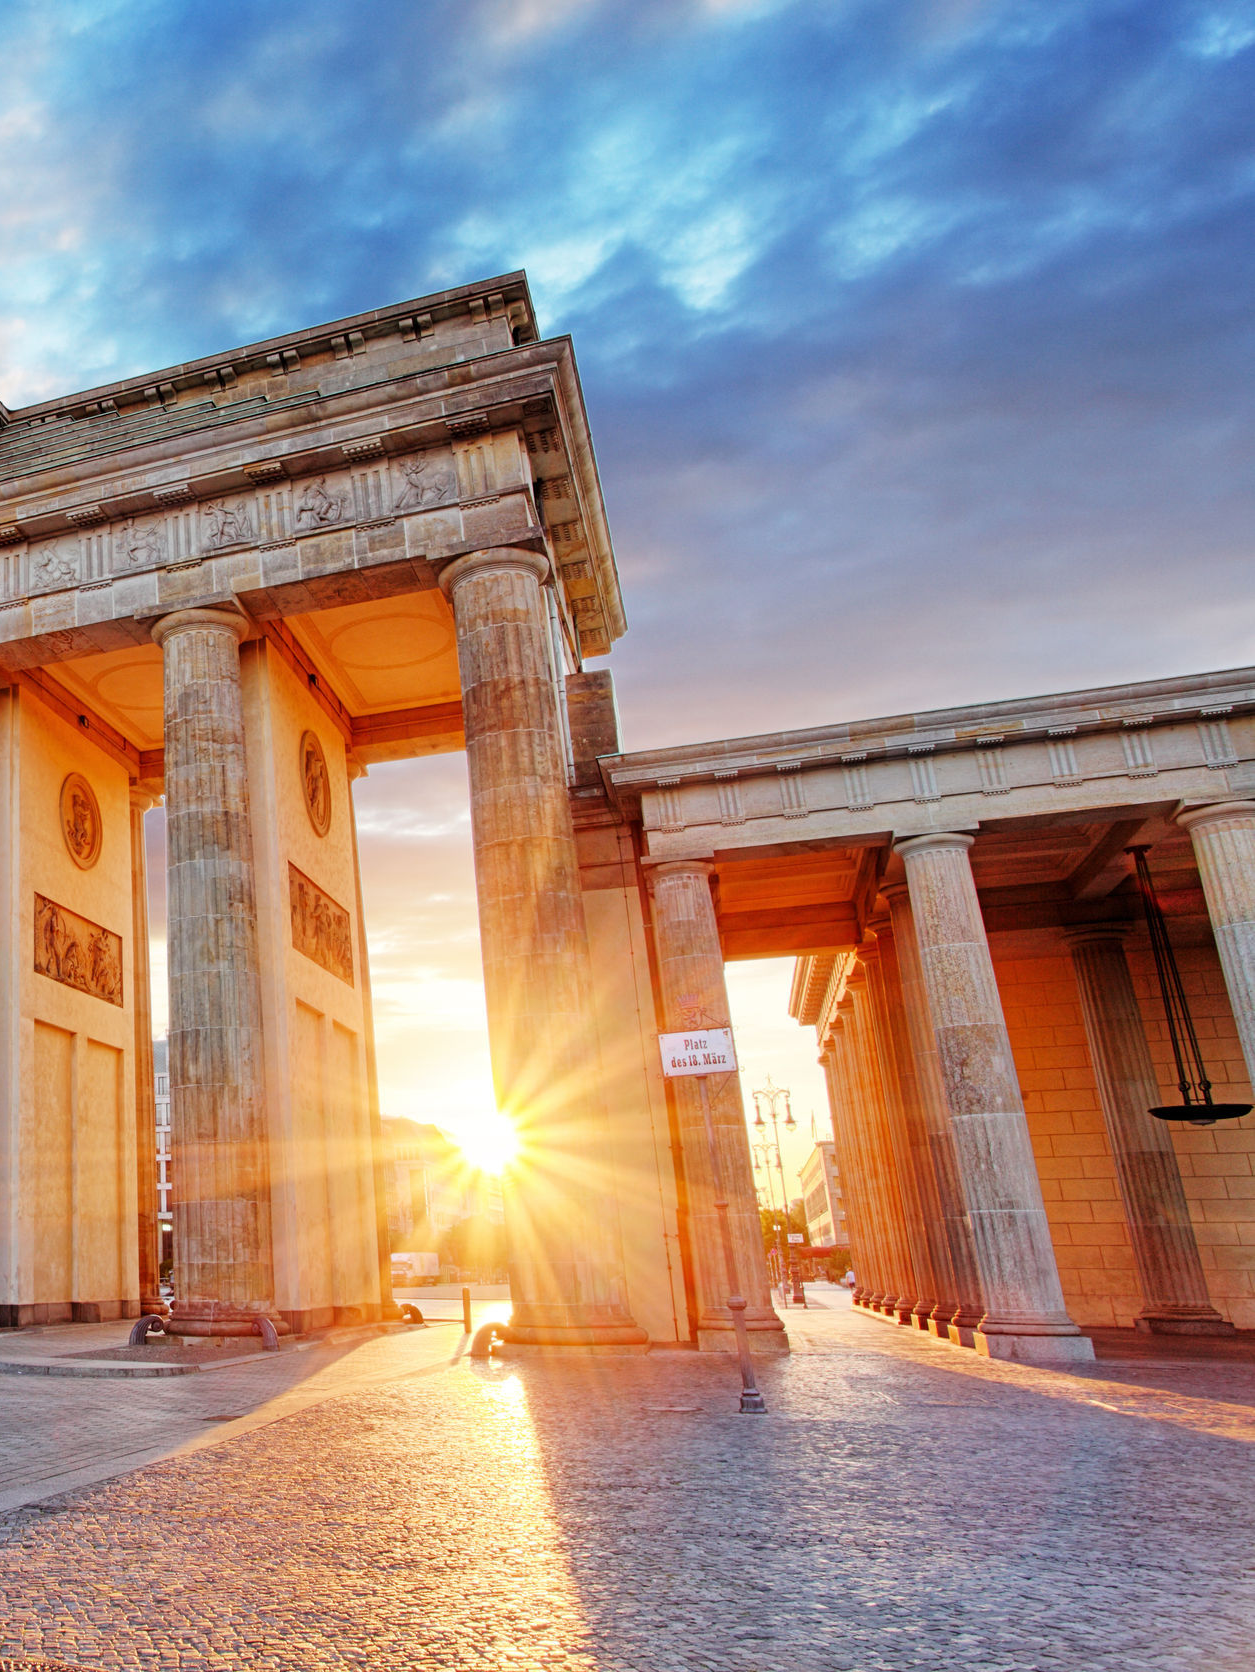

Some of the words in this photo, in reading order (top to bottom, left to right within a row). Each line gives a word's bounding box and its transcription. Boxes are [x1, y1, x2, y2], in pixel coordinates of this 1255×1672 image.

[684, 1039, 708, 1051] Platz
[671, 1056, 687, 1068] des
[689, 1055, 701, 1067] 18.
[702, 1053, 726, 1065] März
